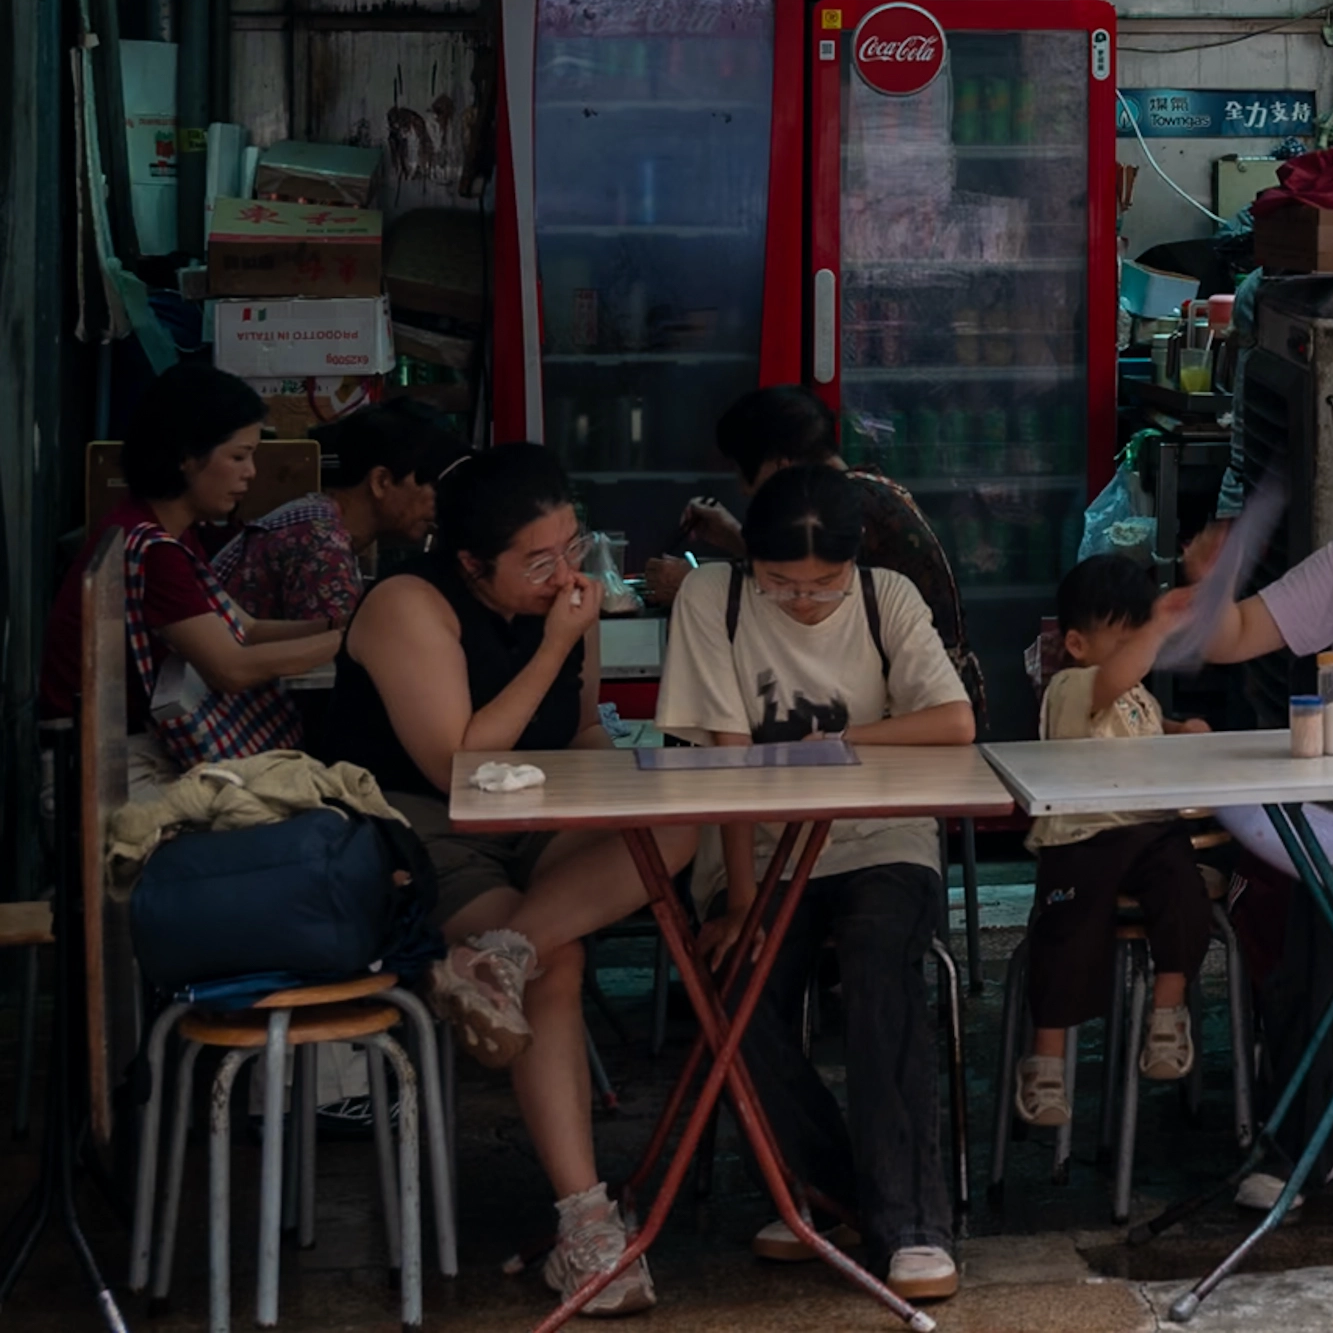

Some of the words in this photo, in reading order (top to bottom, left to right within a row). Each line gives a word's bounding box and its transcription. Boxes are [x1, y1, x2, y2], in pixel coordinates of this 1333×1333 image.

[858, 35, 939, 63] Coca-Cola
[1224, 99, 1312, 129] 全力支持
[1150, 114, 1211, 130] Towngas
[236, 331, 274, 342] ITALIA
[277, 331, 290, 342] IN
[292, 329, 358, 341] PRODOTTO
